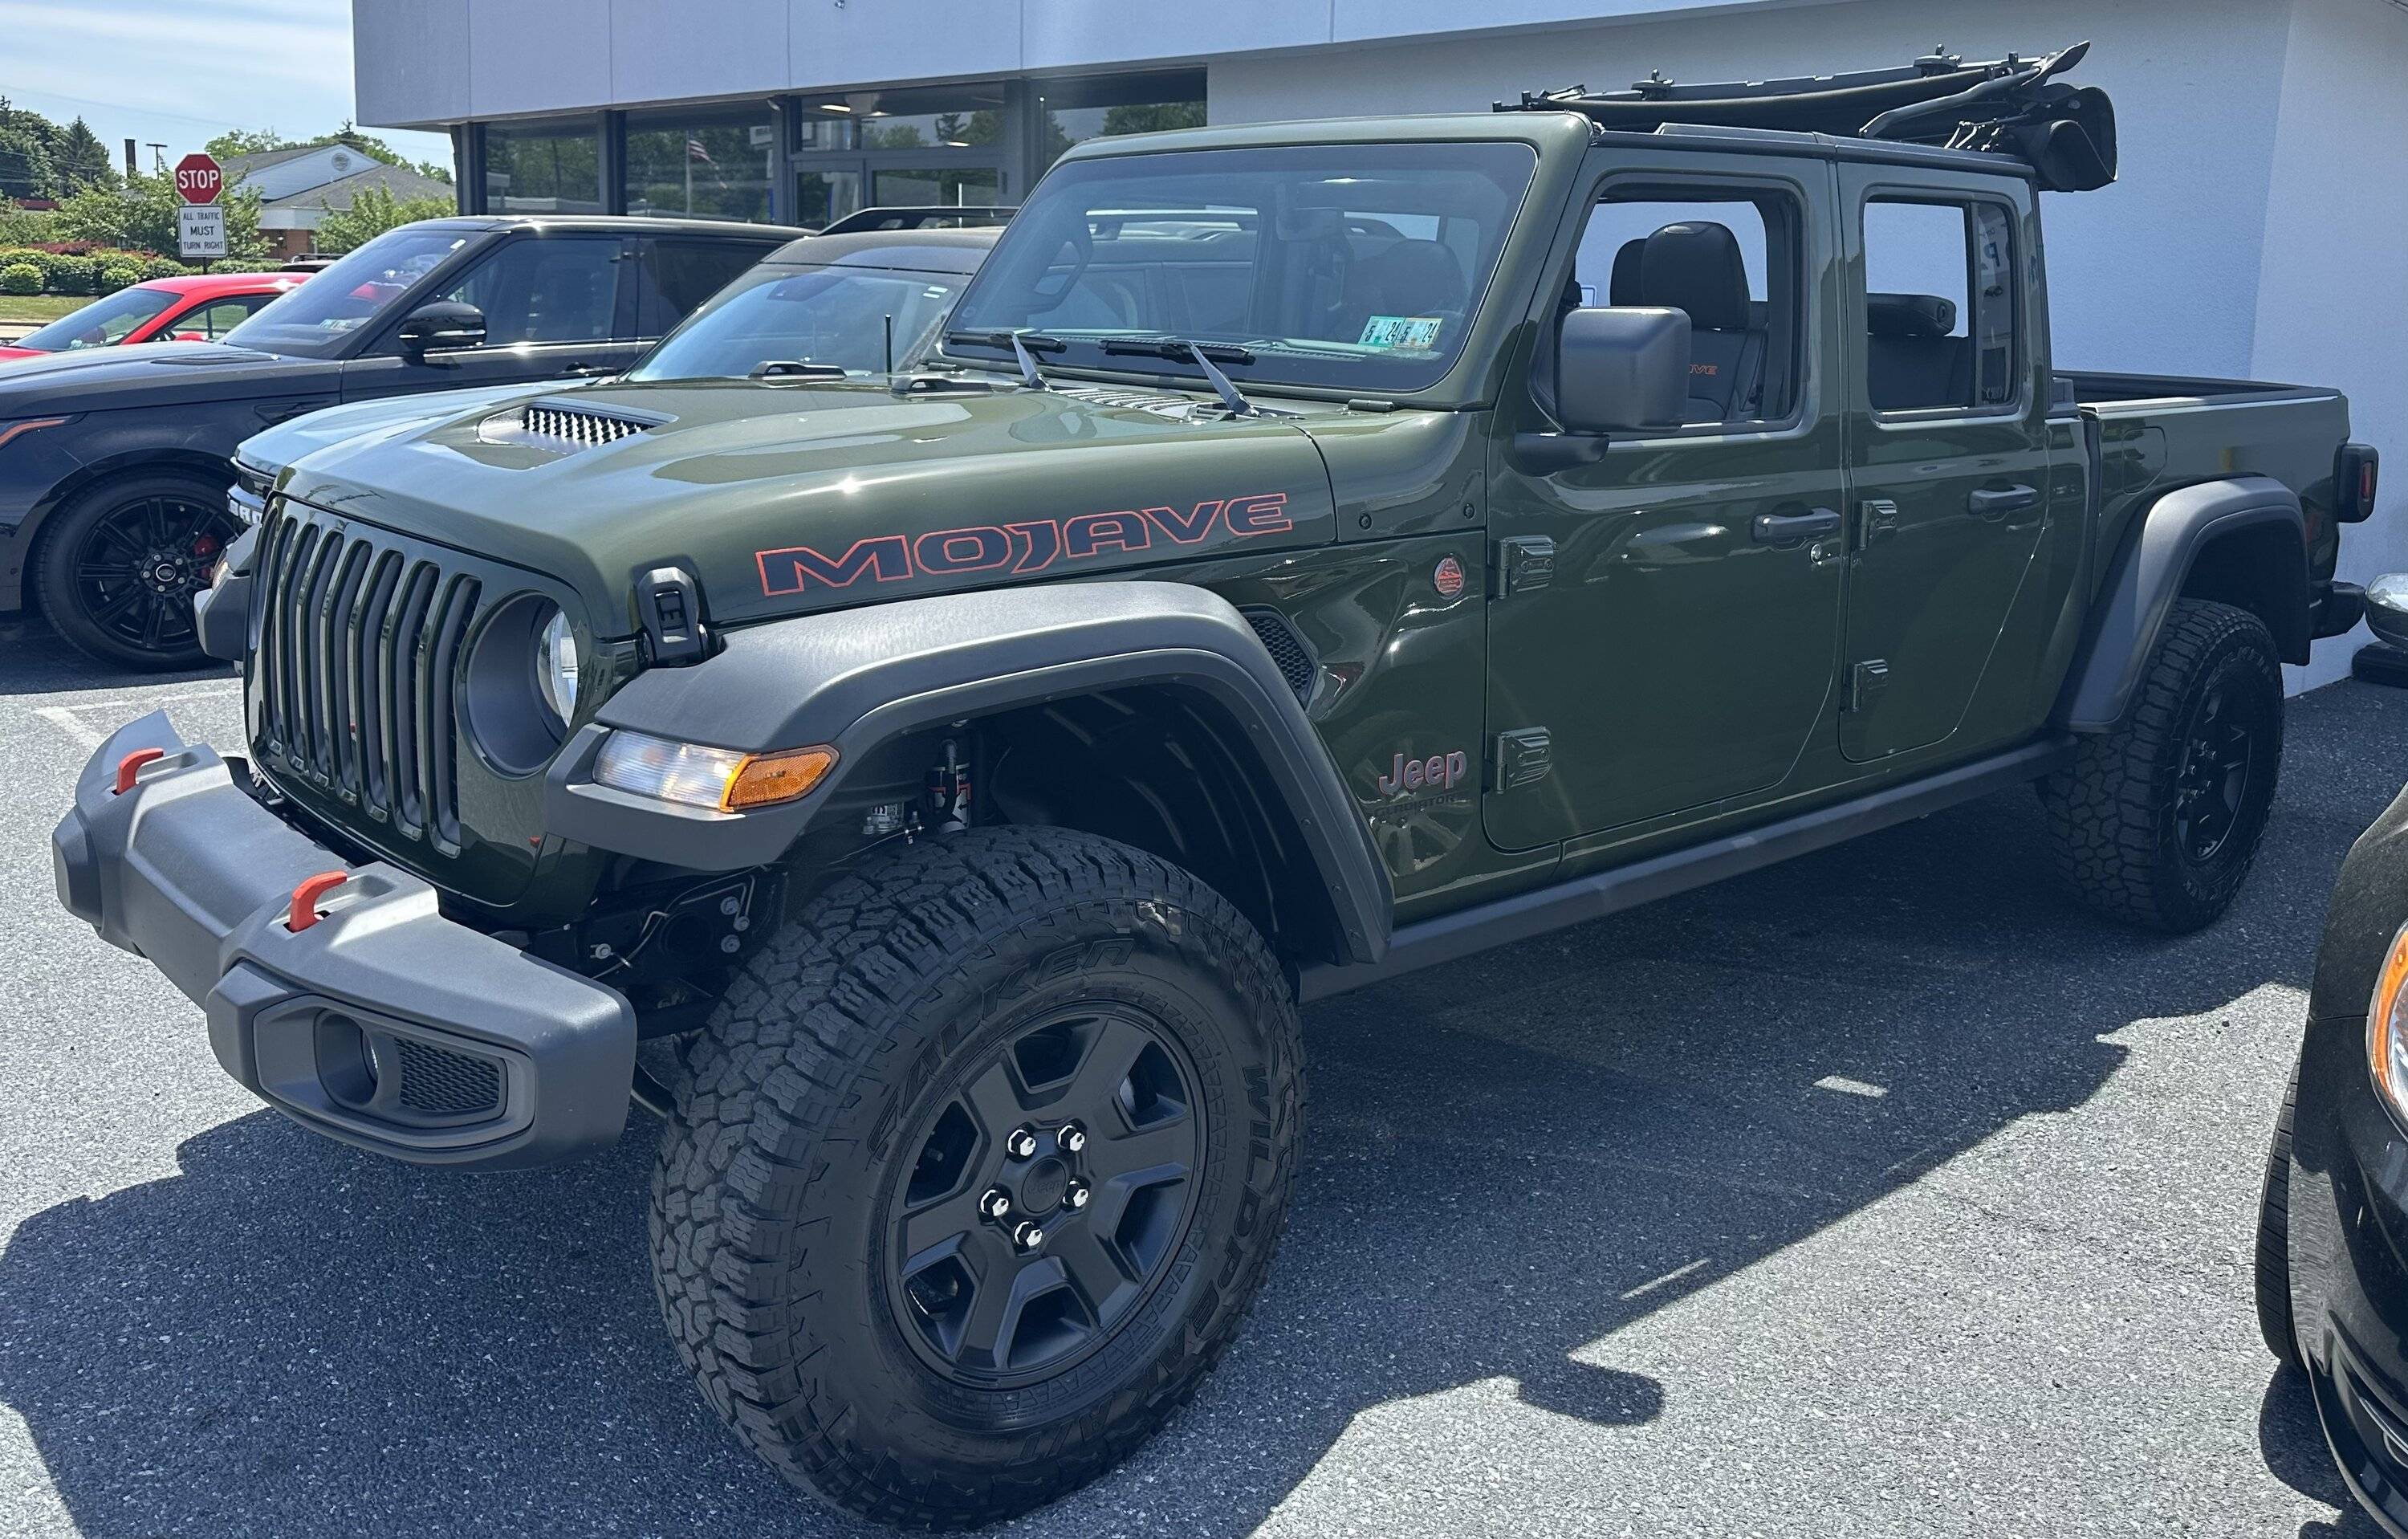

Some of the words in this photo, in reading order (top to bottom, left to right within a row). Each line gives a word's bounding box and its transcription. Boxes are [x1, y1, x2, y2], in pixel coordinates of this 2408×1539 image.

[178, 169, 219, 189] STOP
[183, 212, 193, 221] ALL
[197, 211, 220, 221] TRAFFIC
[190, 226, 214, 236] MUST
[184, 241, 201, 250] TURN
[204, 240, 223, 250] RIGHT
[1422, 323, 1438, 342] 24
[755, 493, 1293, 596] MOJAVE
[1378, 750, 1468, 796] Jeep
[867, 938, 1135, 1156] FALKEN
[1027, 1181, 1063, 1195] Jeep
[1122, 1065, 1275, 1415] WILDPEAK
